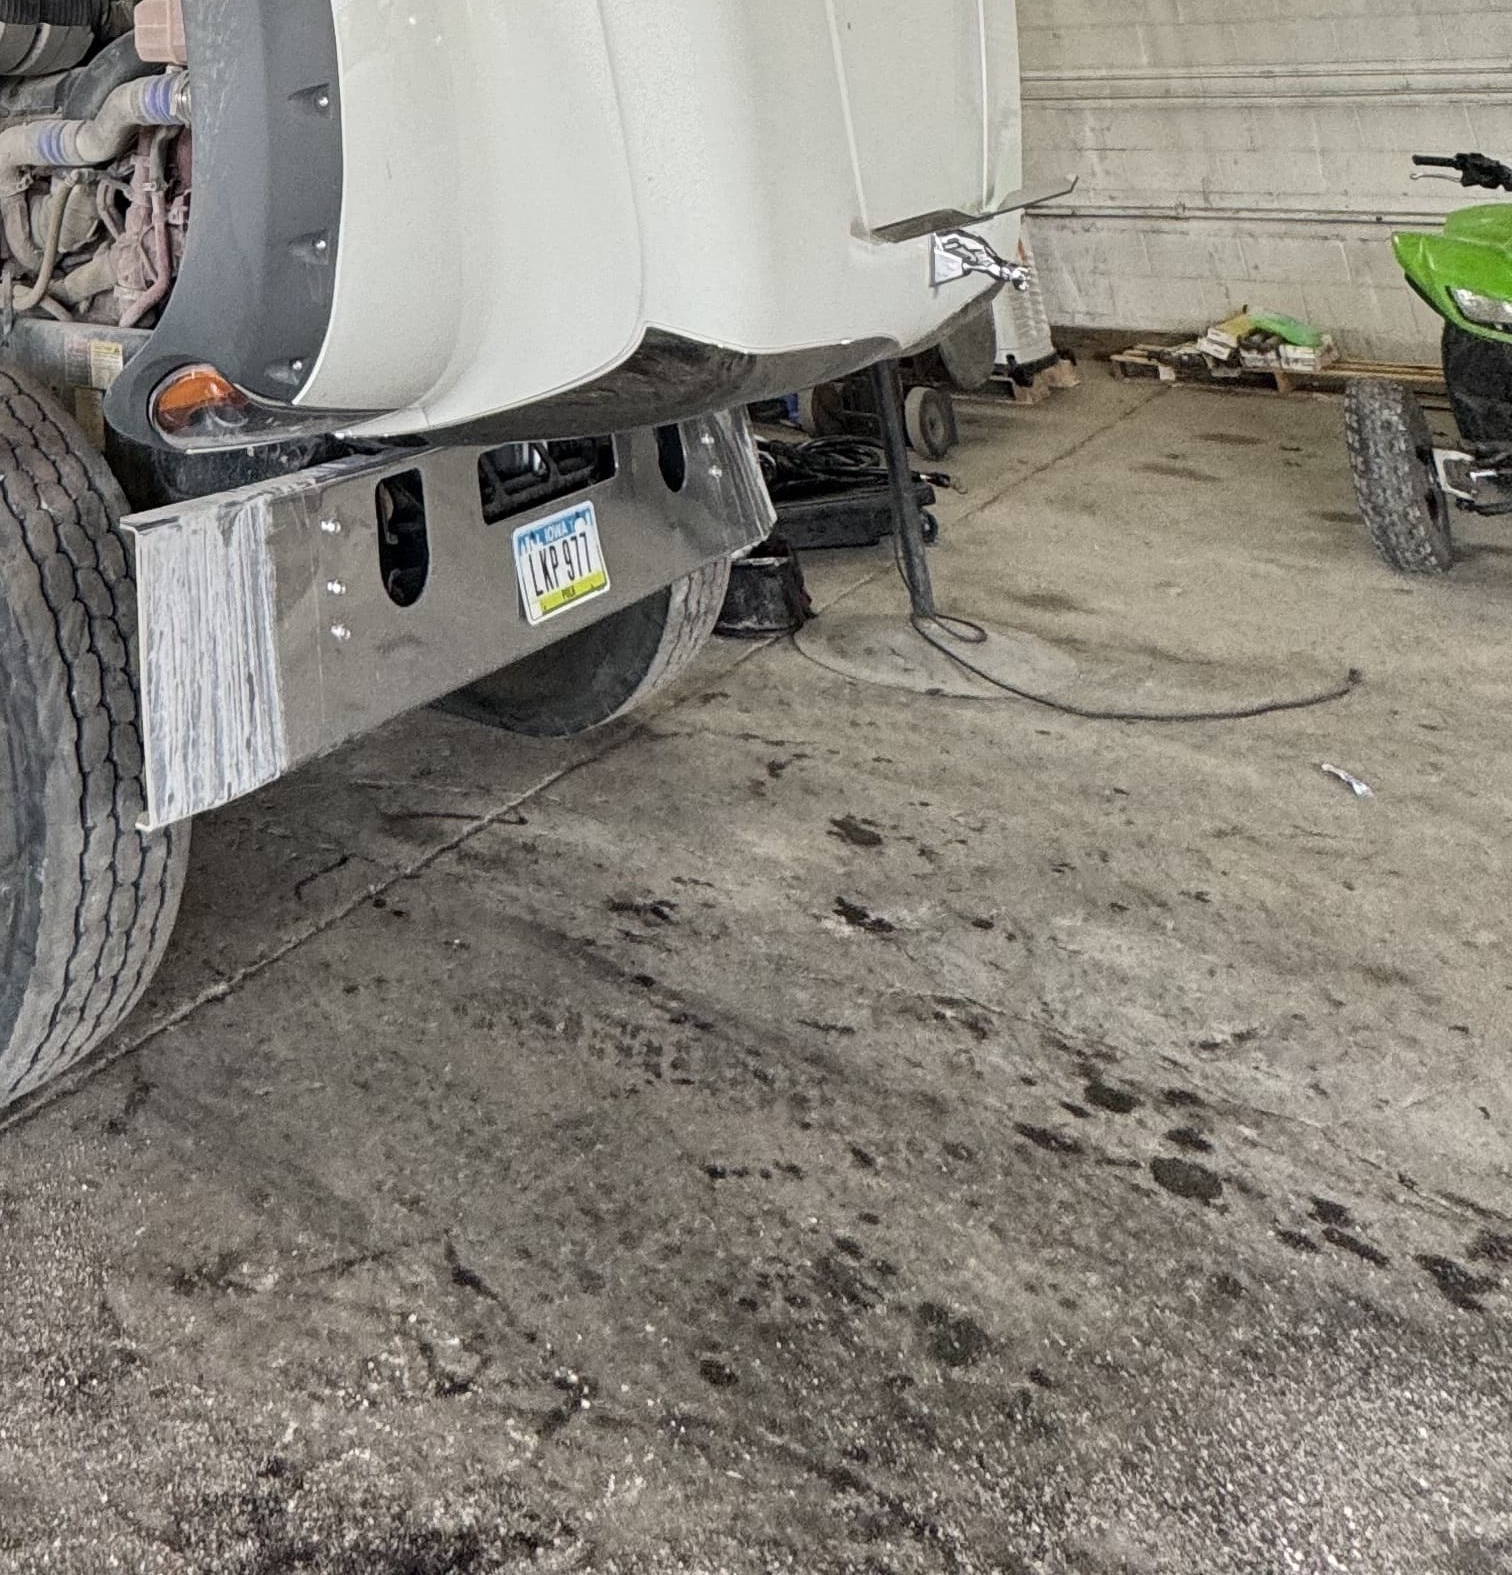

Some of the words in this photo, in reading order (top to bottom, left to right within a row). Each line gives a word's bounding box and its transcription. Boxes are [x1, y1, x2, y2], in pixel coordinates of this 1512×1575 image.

[543, 519, 569, 542] IOWA
[528, 545, 559, 597] LKP
[562, 532, 592, 581] 977
